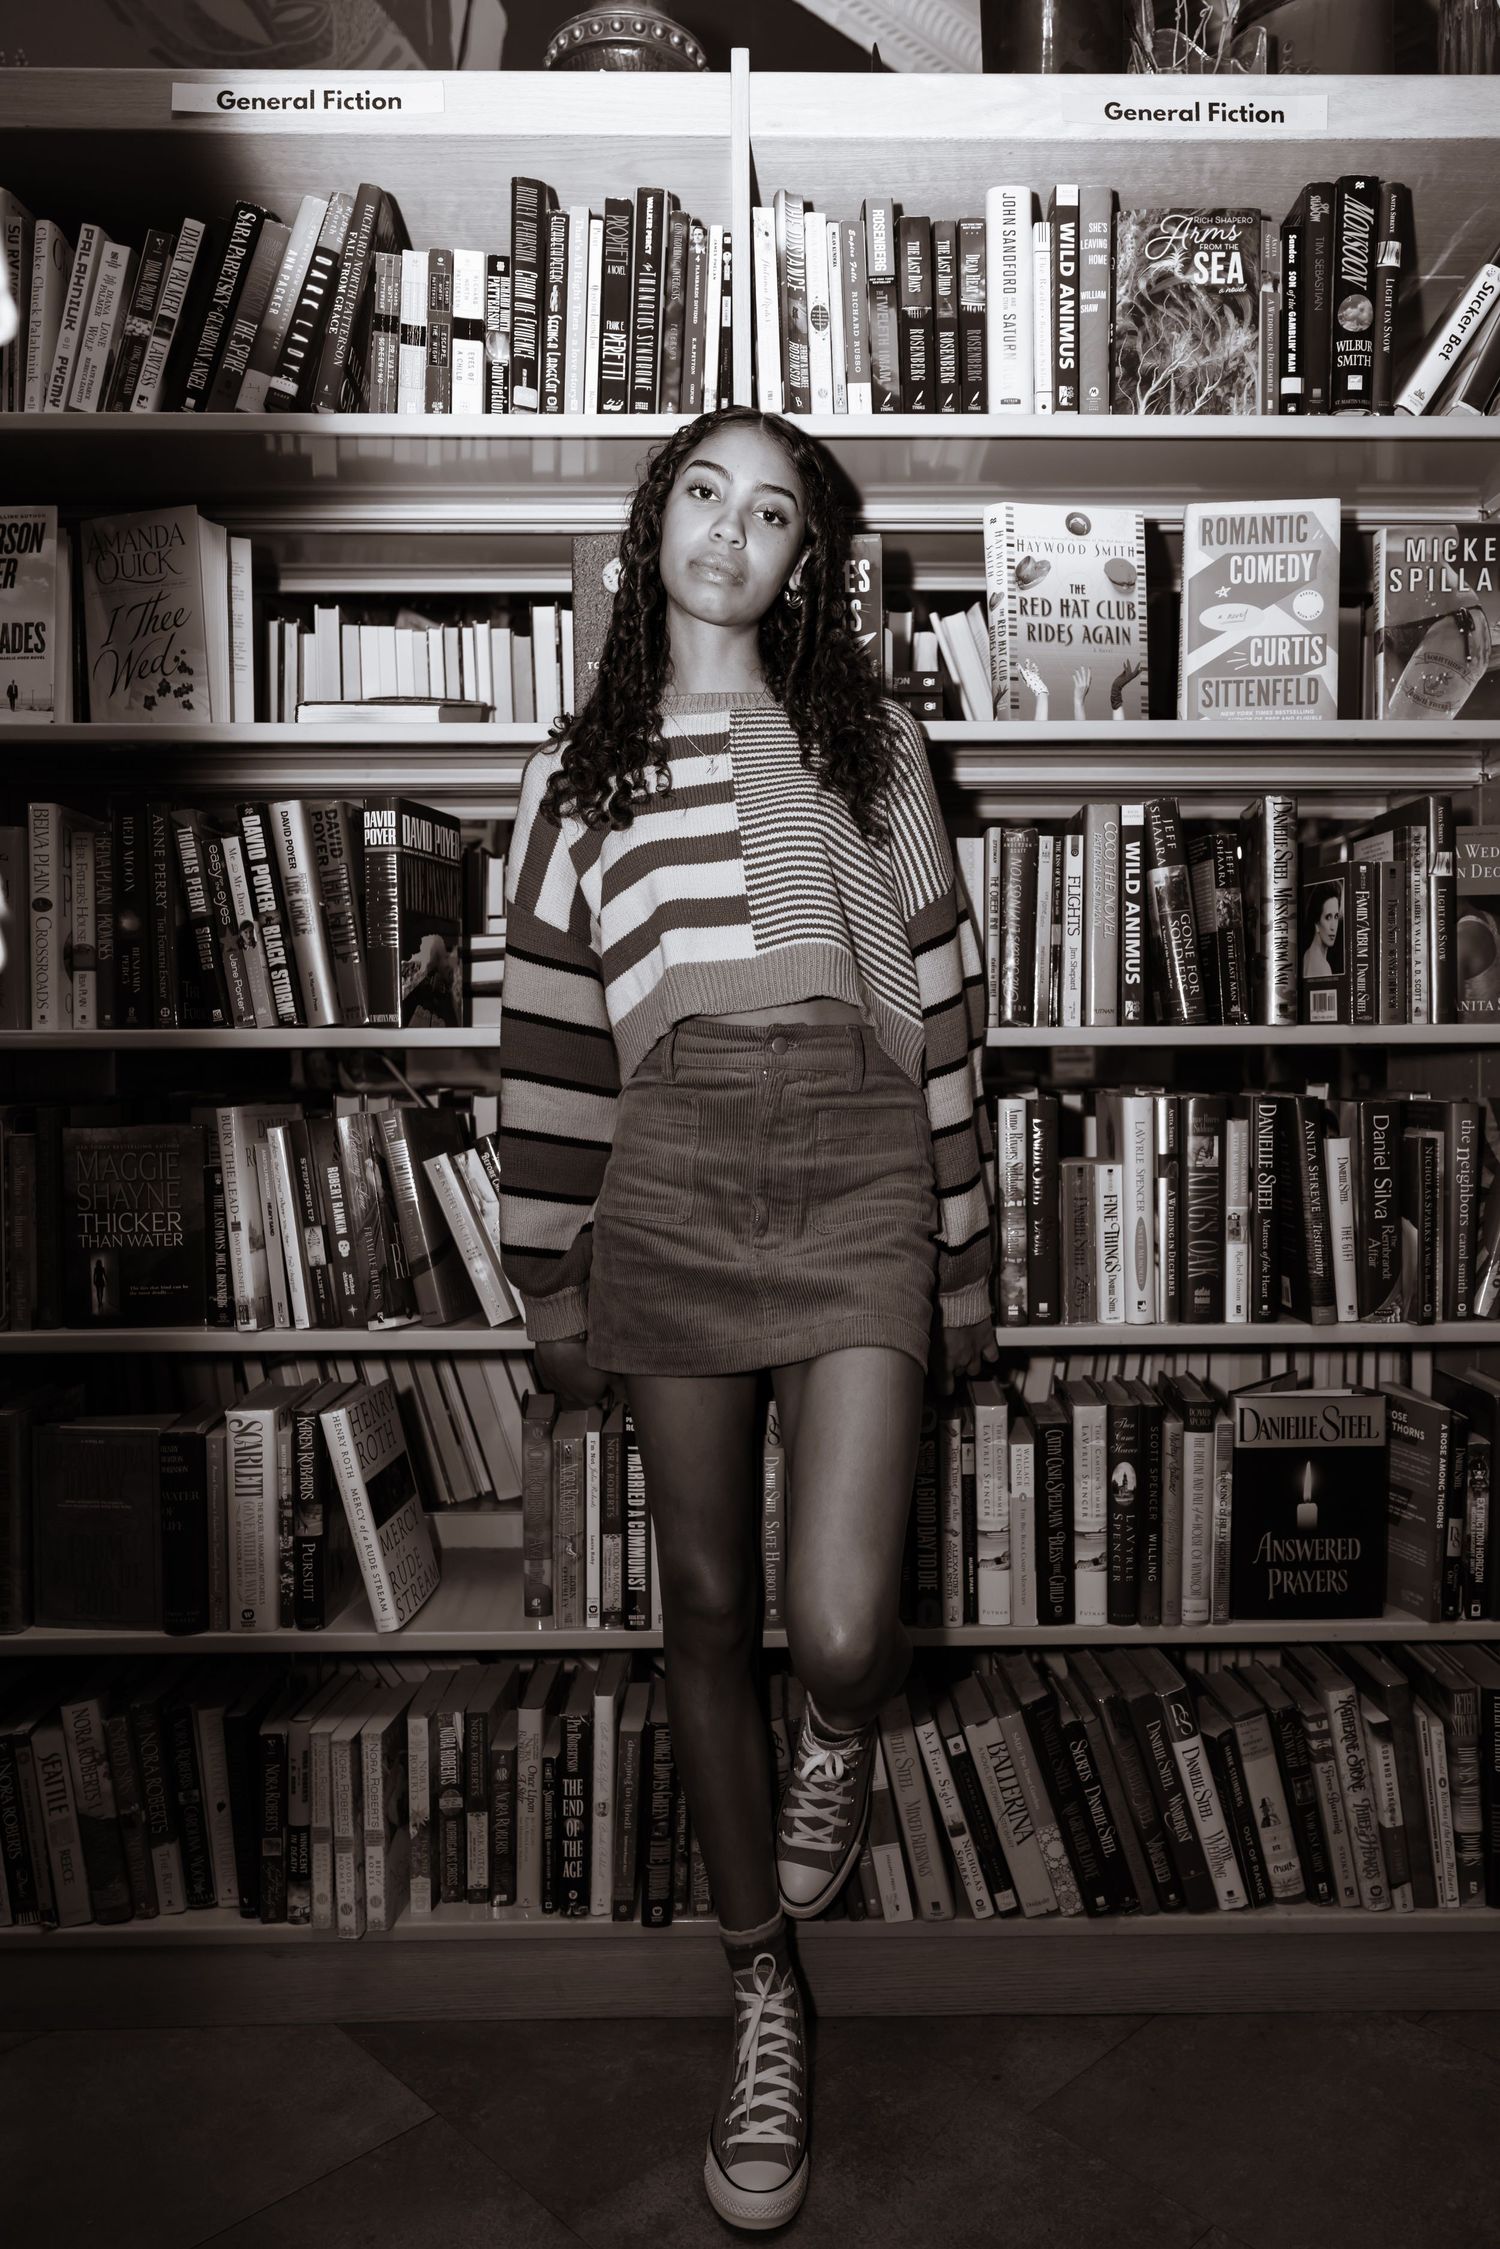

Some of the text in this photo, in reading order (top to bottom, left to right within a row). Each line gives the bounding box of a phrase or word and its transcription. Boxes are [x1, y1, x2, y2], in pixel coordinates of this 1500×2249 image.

[216, 89, 402, 111] General Fiction
[1104, 101, 1285, 124] General Fiction
[515, 221, 537, 263] PEARSON
[605, 214, 629, 265] PROPHET
[871, 209, 888, 272] ROSENBERG
[1088, 222, 1108, 233] SHE'S
[1145, 214, 1243, 260] Arms
[1215, 216, 1254, 224] SHAPERO
[1342, 193, 1374, 290] MONSOON
[786, 230, 806, 292] DISTANCE
[1002, 193, 1017, 295] JOHN SANDFORD
[1080, 237, 1108, 250] LEAVING
[1088, 255, 1108, 265] HOME
[1200, 243, 1239, 251] FROM THE
[213, 246, 247, 308] PARETSKY
[332, 203, 375, 368] RICHARD PATTERSON
[612, 265, 626, 276] NOVEL
[1193, 251, 1245, 285] SEA
[140, 225, 200, 389] DIANA PALMER LAWLESS
[268, 271, 291, 316] PACKER
[513, 270, 538, 360] CHAIN OF EVIDENCE
[1058, 222, 1076, 370] WILD ANIMUS
[1080, 290, 1108, 300] WILLIAM
[1080, 303, 1099, 313] SHAW
[1438, 279, 1496, 362] Sucker Bet
[602, 332, 627, 381] PERETTI
[909, 328, 926, 382] ROSENBERG
[939, 331, 956, 384] ROSENBERG
[966, 329, 983, 382] ROSENBERG
[1336, 340, 1373, 353] WILBUR
[1337, 355, 1371, 367] SMITH
[87, 522, 186, 563] AMANDA
[1016, 538, 1136, 559] HAYWOOD SMITH
[1201, 513, 1309, 547] ROMANTIC
[1405, 537, 1498, 563] MICKE
[95, 549, 184, 584] QUICK
[1229, 552, 1315, 585] COMEDY
[1019, 596, 1137, 621] RED HAT CLUB
[1069, 584, 1087, 596] THE
[127, 590, 193, 638] Thee
[1026, 622, 1132, 646] RIDES AGAIN
[93, 633, 179, 698] Wed
[1249, 636, 1324, 667] CURTIS
[1200, 676, 1320, 708] SITTENFELD
[280, 810, 297, 870] DAVID POYER
[364, 810, 397, 828] DAVID
[364, 828, 397, 846] POYER
[402, 814, 461, 861] DAVID POYER
[1150, 805, 1166, 867] SHAARA
[1163, 818, 1177, 850] JEFF
[177, 826, 200, 877] THOMAS
[31, 807, 53, 1010] BELVA PLAIN CROSSROADS
[241, 815, 296, 1016] DAVID POYER BLACK STORM
[1067, 875, 1081, 937] FLIGHTS
[1125, 841, 1141, 985] WILD ANIMUS
[1461, 1119, 1475, 1144] the
[75, 1150, 182, 1182] MAGGIE
[221, 1114, 240, 1214] BURY THE LEAD
[1257, 1103, 1277, 1214] DANIELLE STEEL
[1305, 1121, 1321, 1212] ANITA SHREVE
[1373, 1114, 1392, 1219] Daniel Silva
[76, 1182, 182, 1212] SHAYNE
[326, 1166, 349, 1235] ROBERT RANKIN
[1103, 1194, 1118, 1222] FINE
[77, 1211, 184, 1233] THICKER
[78, 1232, 184, 1248] THAN WATER
[1188, 1239, 1219, 1279] OAK
[348, 1384, 396, 1437] HENRY
[1238, 1404, 1380, 1444] DANIELLE STEEL
[1391, 1423, 1426, 1441] THORNS
[228, 1418, 264, 1498] SCARLETT
[356, 1418, 398, 1470] ROTH
[1147, 1425, 1160, 1583] SCOTT SPENCER WILLING
[1435, 1432, 1448, 1530] ROSE AMONG THORNS
[331, 1415, 347, 1448] HENRY
[341, 1450, 355, 1479] ROTH
[350, 1488, 366, 1524] MERCY
[365, 1542, 378, 1571] RUDE
[372, 1573, 389, 1613] STREAM
[379, 1500, 420, 1557] MERCY
[628, 1453, 646, 1592] MARRIED COMMUNIST
[388, 1545, 423, 1596] RUDE
[1112, 1512, 1123, 1583] SPENCER
[1252, 1531, 1362, 1565] ANSWERED
[301, 1542, 316, 1602] PURSUIT
[395, 1562, 440, 1624] STREAM
[1267, 1567, 1349, 1601] PRAYERS
[140, 1731, 169, 1835] NORA ROBERTS
[369, 1777, 380, 1829] ROBERTS
[563, 1778, 584, 1796] THE
[986, 1740, 1035, 1846] BALLERINA
[563, 1799, 584, 1817] END
[566, 1820, 580, 1837] OF
[562, 1840, 584, 1858] THE
[562, 1860, 583, 1878] AGE
[961, 1838, 984, 1892] NICHOLAS
